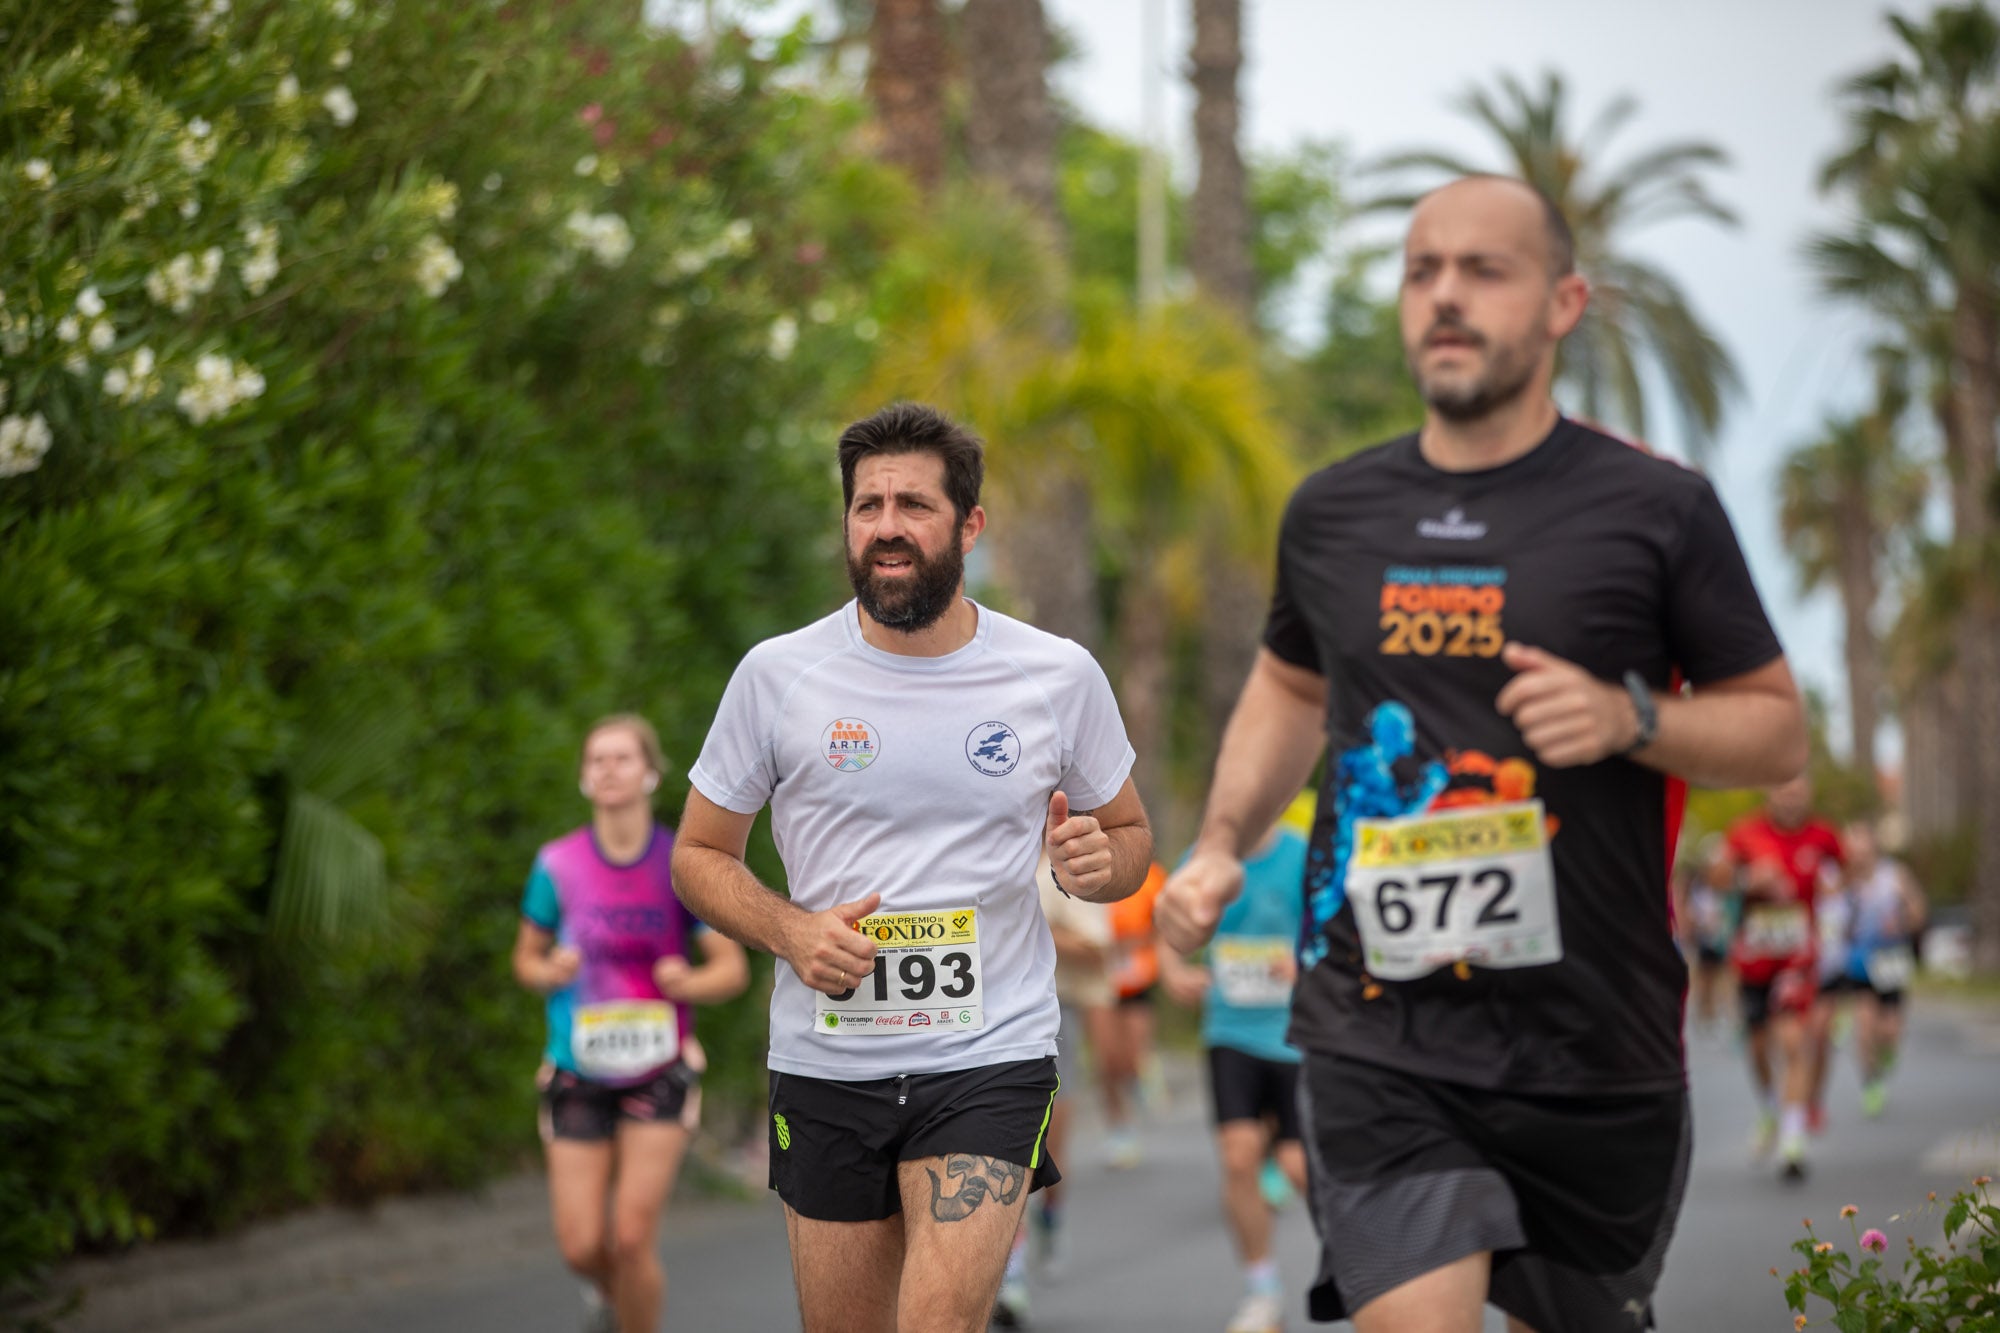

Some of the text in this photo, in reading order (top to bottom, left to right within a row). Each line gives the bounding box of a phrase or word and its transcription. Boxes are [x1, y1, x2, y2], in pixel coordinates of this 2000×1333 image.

[1380, 583, 1505, 614] FONDO
[1379, 611, 1505, 658] 2025
[1374, 867, 1520, 935] 672
[861, 923, 945, 941] FONDO
[865, 917, 895, 926] GRAN
[897, 915, 938, 925] PREMIO
[840, 1016, 873, 1024] Cruzcampo
